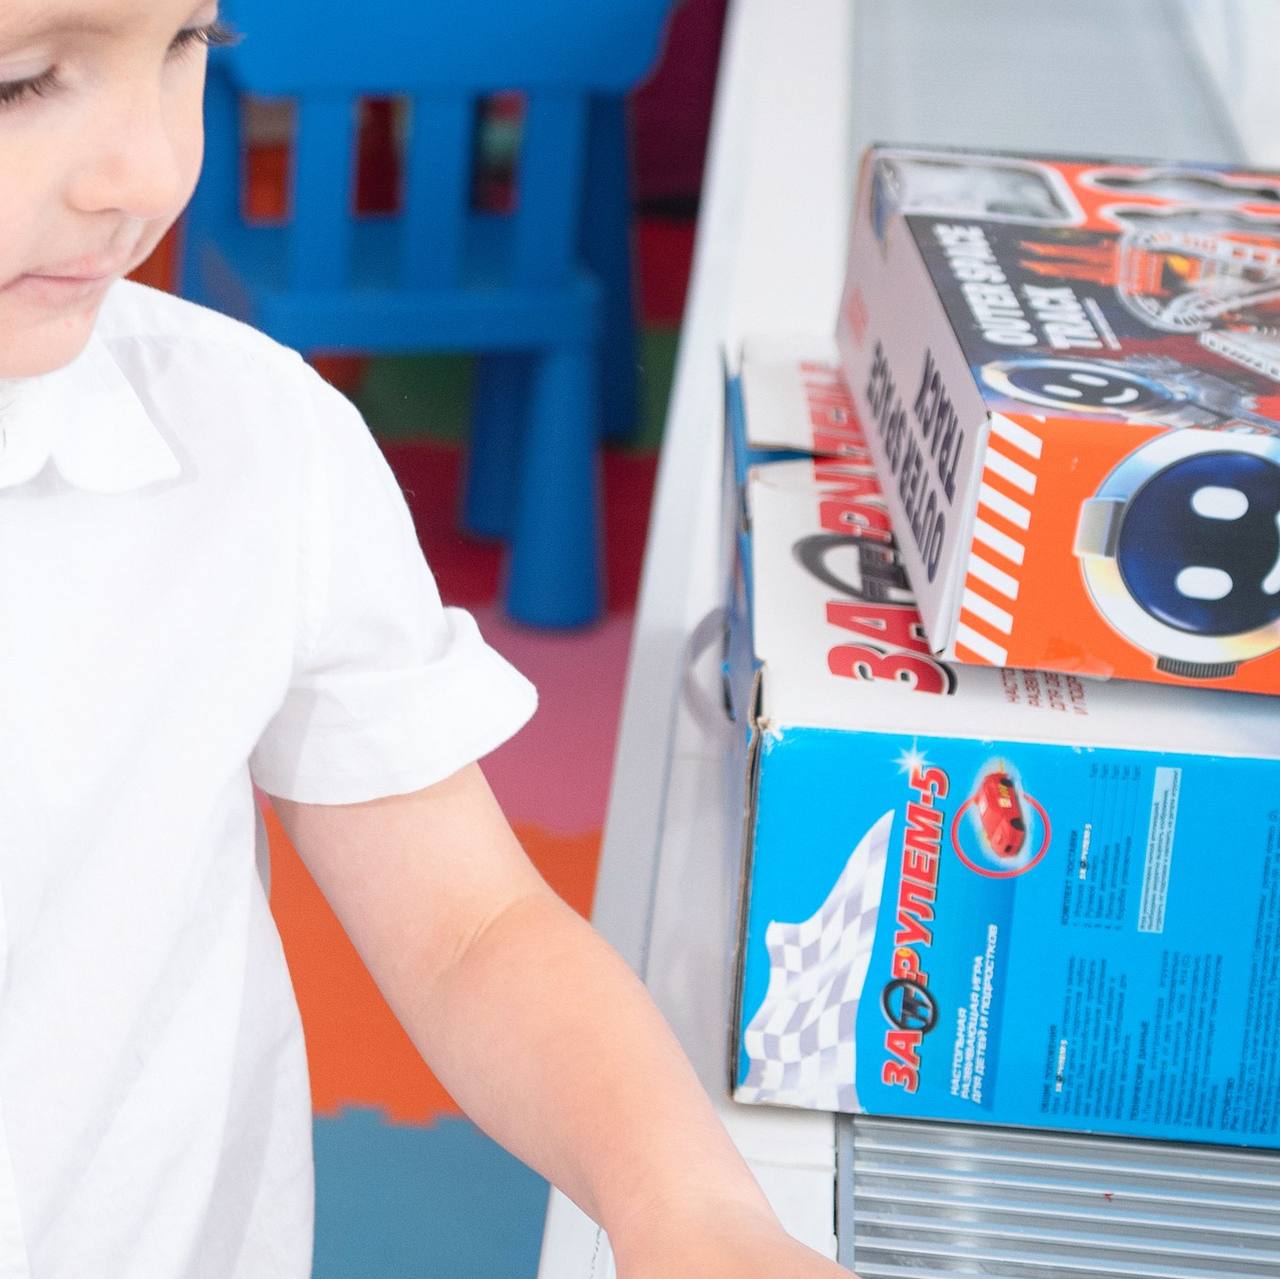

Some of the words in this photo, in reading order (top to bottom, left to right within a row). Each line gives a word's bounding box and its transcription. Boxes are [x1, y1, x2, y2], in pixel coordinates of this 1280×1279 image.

[933, 224, 1006, 283] SPACE
[961, 282, 1038, 346] OUTER
[1022, 283, 1103, 350] TRACK
[866, 339, 909, 476] SPACE
[914, 347, 965, 507] TRACK
[899, 428, 946, 584] OUTER
[980, 925, 998, 1014] ПОДРОСТКОВ
[951, 1007, 968, 1096] НАСТОЛЬНАЯ
[960, 995, 979, 1099] РАЗВИВАЮЩАЯ
[972, 955, 984, 991] ИГРА
[975, 1030, 988, 1074] ДЕТЕЙ
[971, 1076, 983, 1103] ДЛЯ
